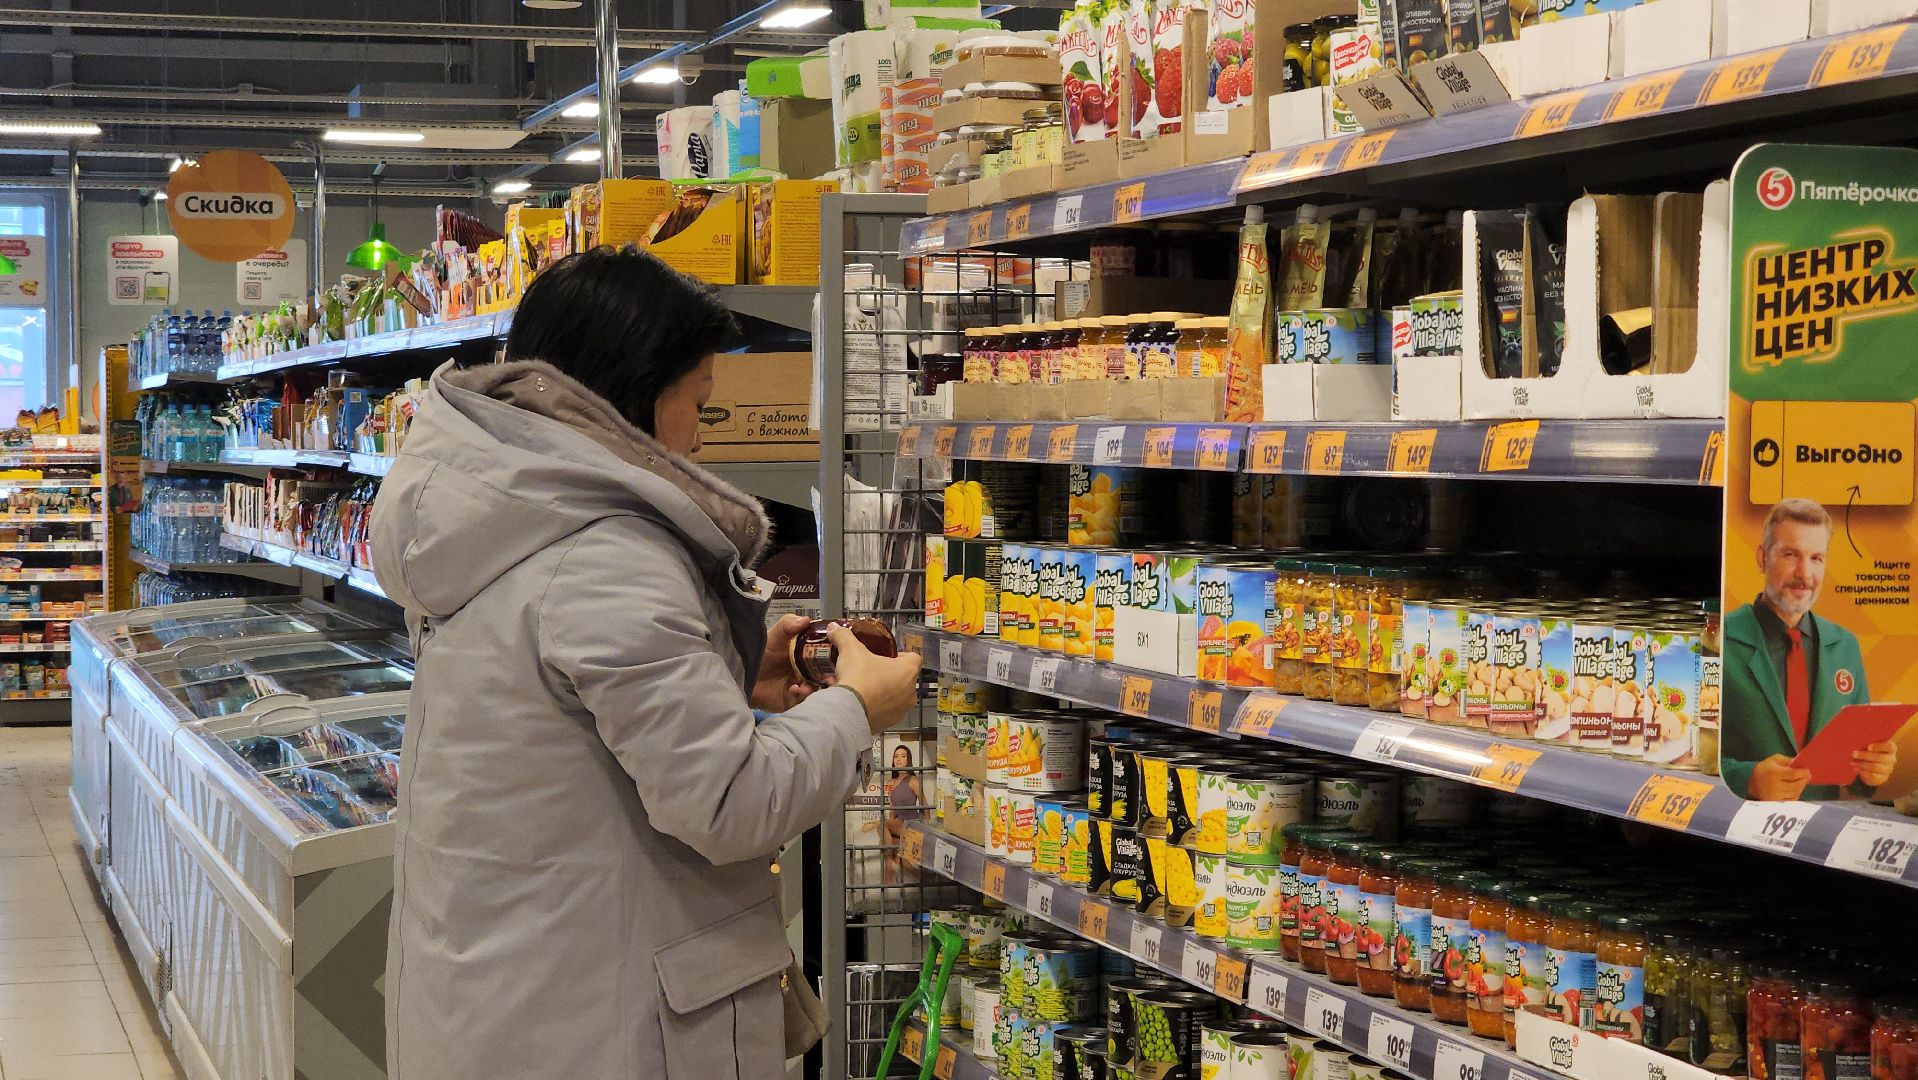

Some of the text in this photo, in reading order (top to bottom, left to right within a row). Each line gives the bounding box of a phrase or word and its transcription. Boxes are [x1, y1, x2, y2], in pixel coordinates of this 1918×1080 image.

[1848, 42, 1882, 68] 139
[1436, 64, 1461, 81] Global
[1731, 64, 1763, 89] 139
[1444, 77, 1471, 94] Village
[1634, 83, 1663, 108] 139
[690, 133, 709, 178] Papia
[184, 195, 274, 216] Скидка
[252, 260, 289, 268] очереди?
[1496, 250, 1523, 261] Globa
[1498, 259, 1523, 270] Villa
[1758, 240, 1885, 289] ЦЕНТР
[1497, 286, 1523, 294] МАСЛИН
[1503, 294, 1523, 303] КОСТО
[1757, 268, 1917, 321] НИЗКИХ
[1755, 317, 1833, 359] ЦЕН
[748, 408, 809, 423] С забото
[748, 424, 809, 437] о важном
[1106, 439, 1119, 455] 199
[1156, 440, 1169, 457] 104
[1264, 445, 1278, 463] 129
[1325, 446, 1336, 465] 89
[1407, 445, 1426, 466] 149
[1505, 440, 1527, 460] 129
[1795, 441, 1902, 471] Выгодно
[1874, 560, 1910, 569] Ищите
[1856, 574, 1895, 583] товары
[1200, 583, 1230, 600] Global
[1835, 585, 1910, 593] специальным
[1200, 598, 1232, 616] Village
[1855, 597, 1910, 607] ценником
[1137, 632, 1148, 648] 6X1
[1574, 639, 1613, 658] Global
[1574, 657, 1613, 679] Village
[1041, 670, 1053, 686] 159
[1131, 690, 1147, 709] 299
[1202, 705, 1216, 723] 169
[1252, 711, 1271, 726] 159
[1501, 762, 1520, 780] 99
[1660, 793, 1691, 817] 159
[1761, 812, 1797, 838] 199
[1868, 837, 1904, 864] 182
[1113, 869, 1136, 877] КУКУРУЗ
[1114, 862, 1136, 870] СЛАДКА
[1144, 938, 1155, 958] 119
[1196, 961, 1210, 980] 169
[1225, 974, 1239, 991] 129
[1597, 974, 1620, 989] Global
[1265, 986, 1281, 1008] 139
[1598, 988, 1624, 1003] Village
[1322, 1008, 1338, 1031] 139
[1387, 1034, 1405, 1058] 109
[1550, 1036, 1572, 1051] Global
[1551, 1050, 1573, 1070] Village
[1648, 1063, 1665, 1075] Global
[1459, 1063, 1474, 1080] 99
